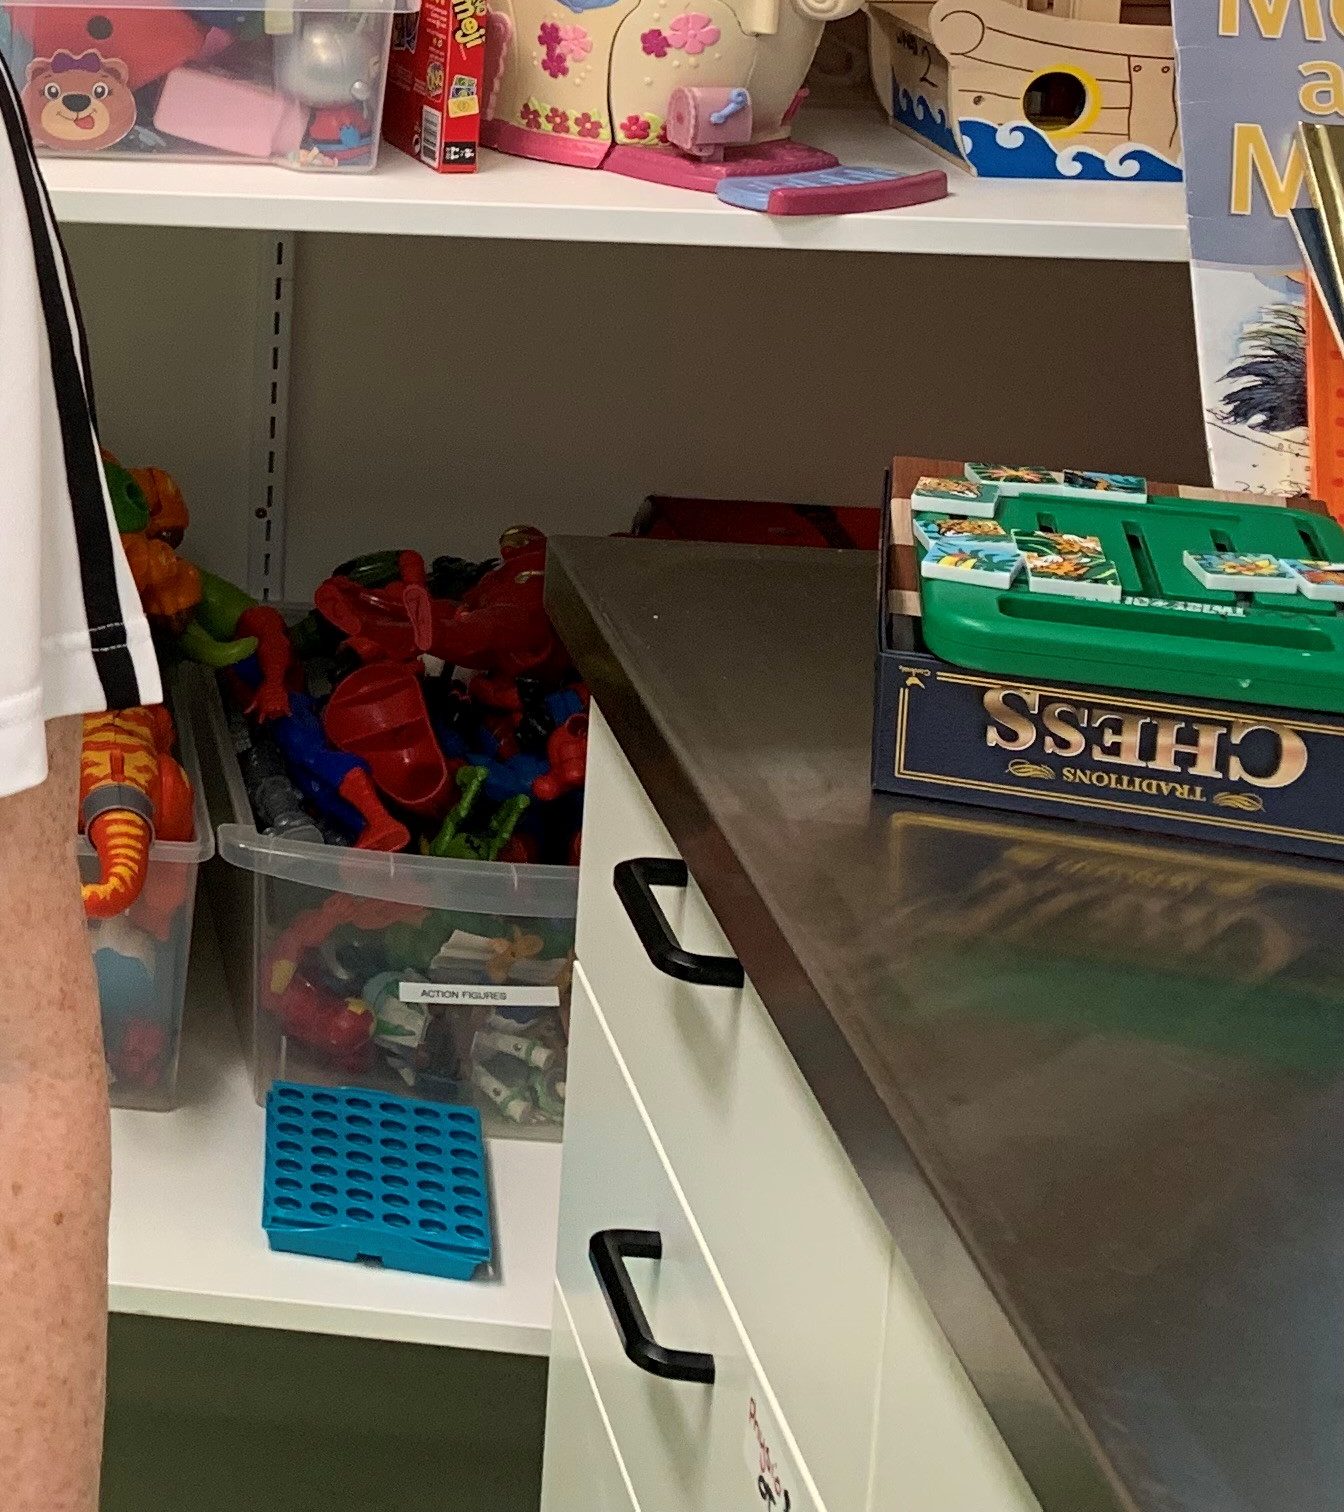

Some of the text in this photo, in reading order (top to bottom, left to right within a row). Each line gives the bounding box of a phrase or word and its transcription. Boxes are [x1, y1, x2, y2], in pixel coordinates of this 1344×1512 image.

[982, 686, 1308, 789] CHESS
[1062, 766, 1206, 802] TRADITIONS
[421, 989, 507, 1001] ACTION FIGURES
